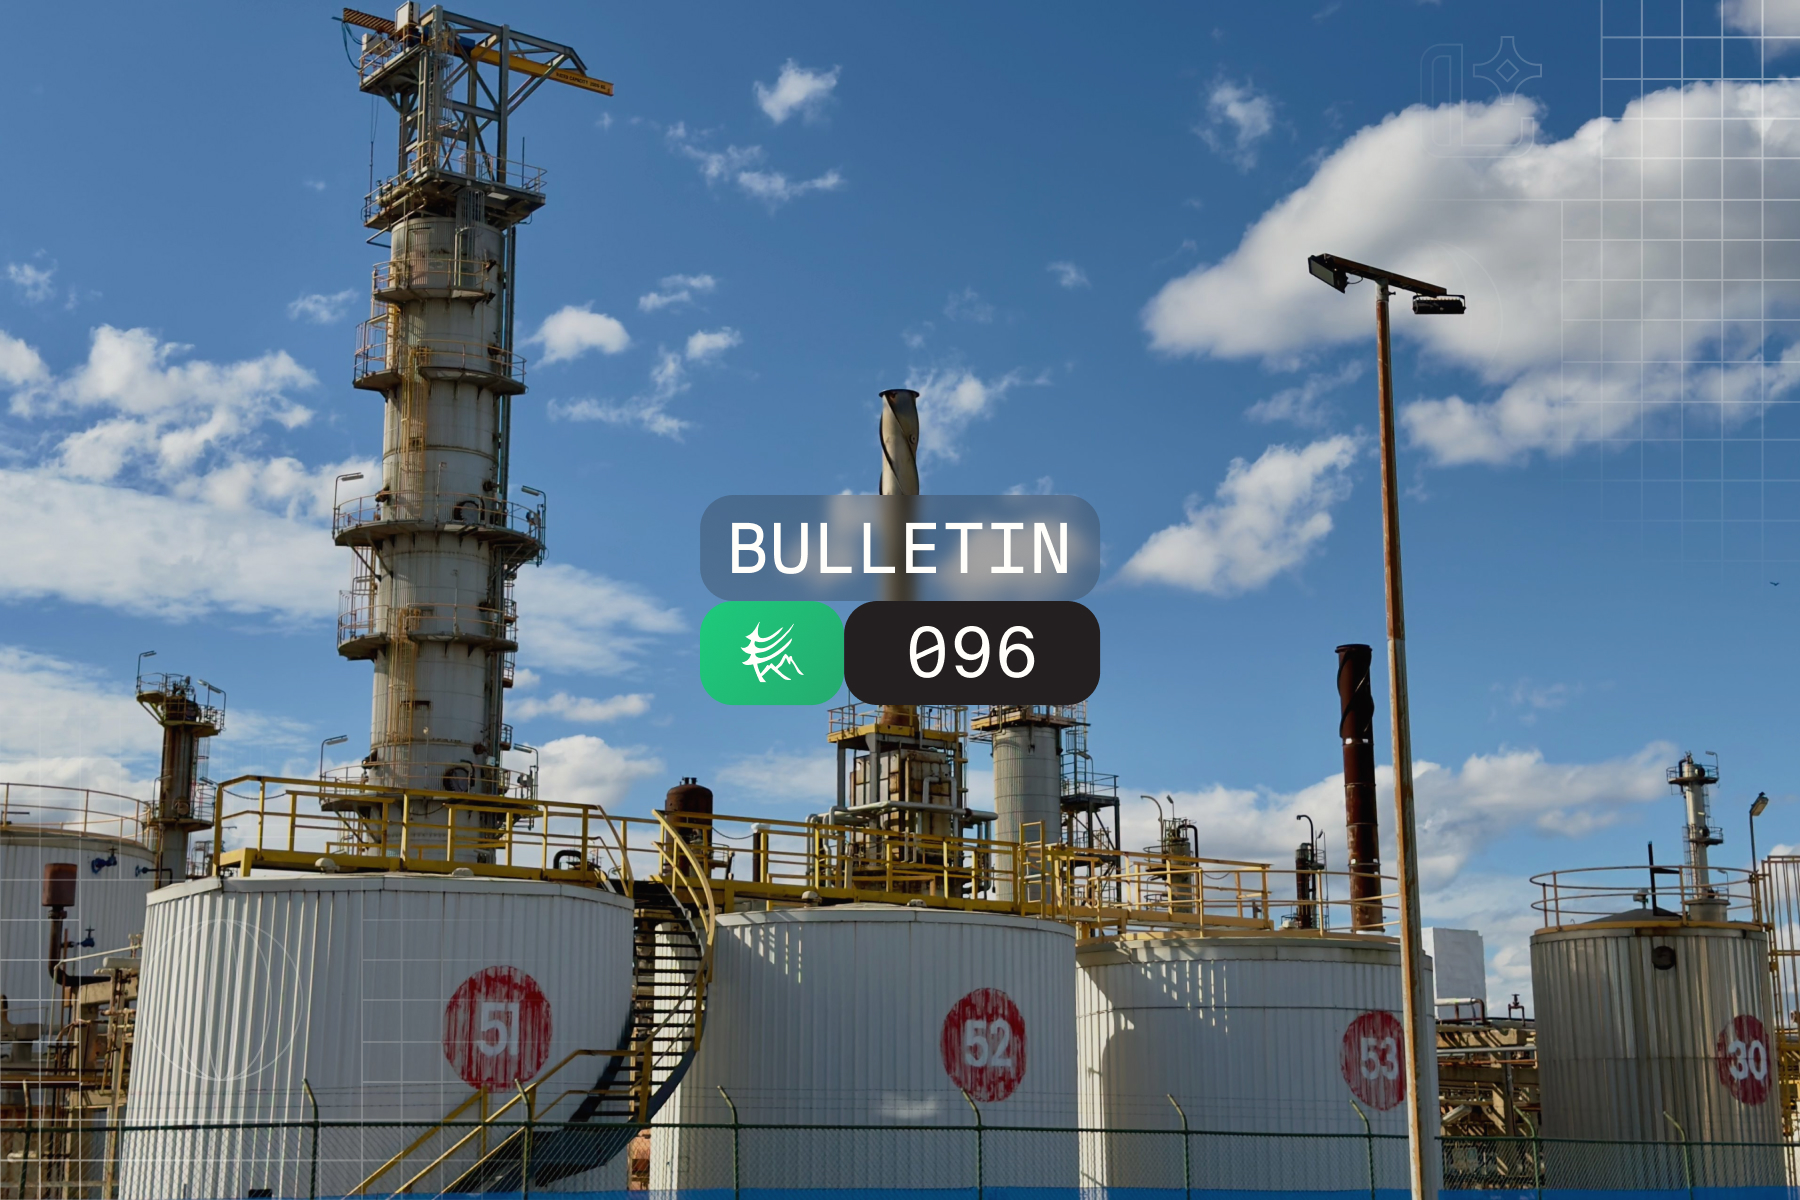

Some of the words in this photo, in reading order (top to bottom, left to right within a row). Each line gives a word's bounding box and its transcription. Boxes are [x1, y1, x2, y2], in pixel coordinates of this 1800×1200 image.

[476, 1001, 520, 1057] 51
[964, 1017, 1012, 1068] 52
[1361, 1036, 1399, 1080] 53
[1728, 1039, 1768, 1081] 30
